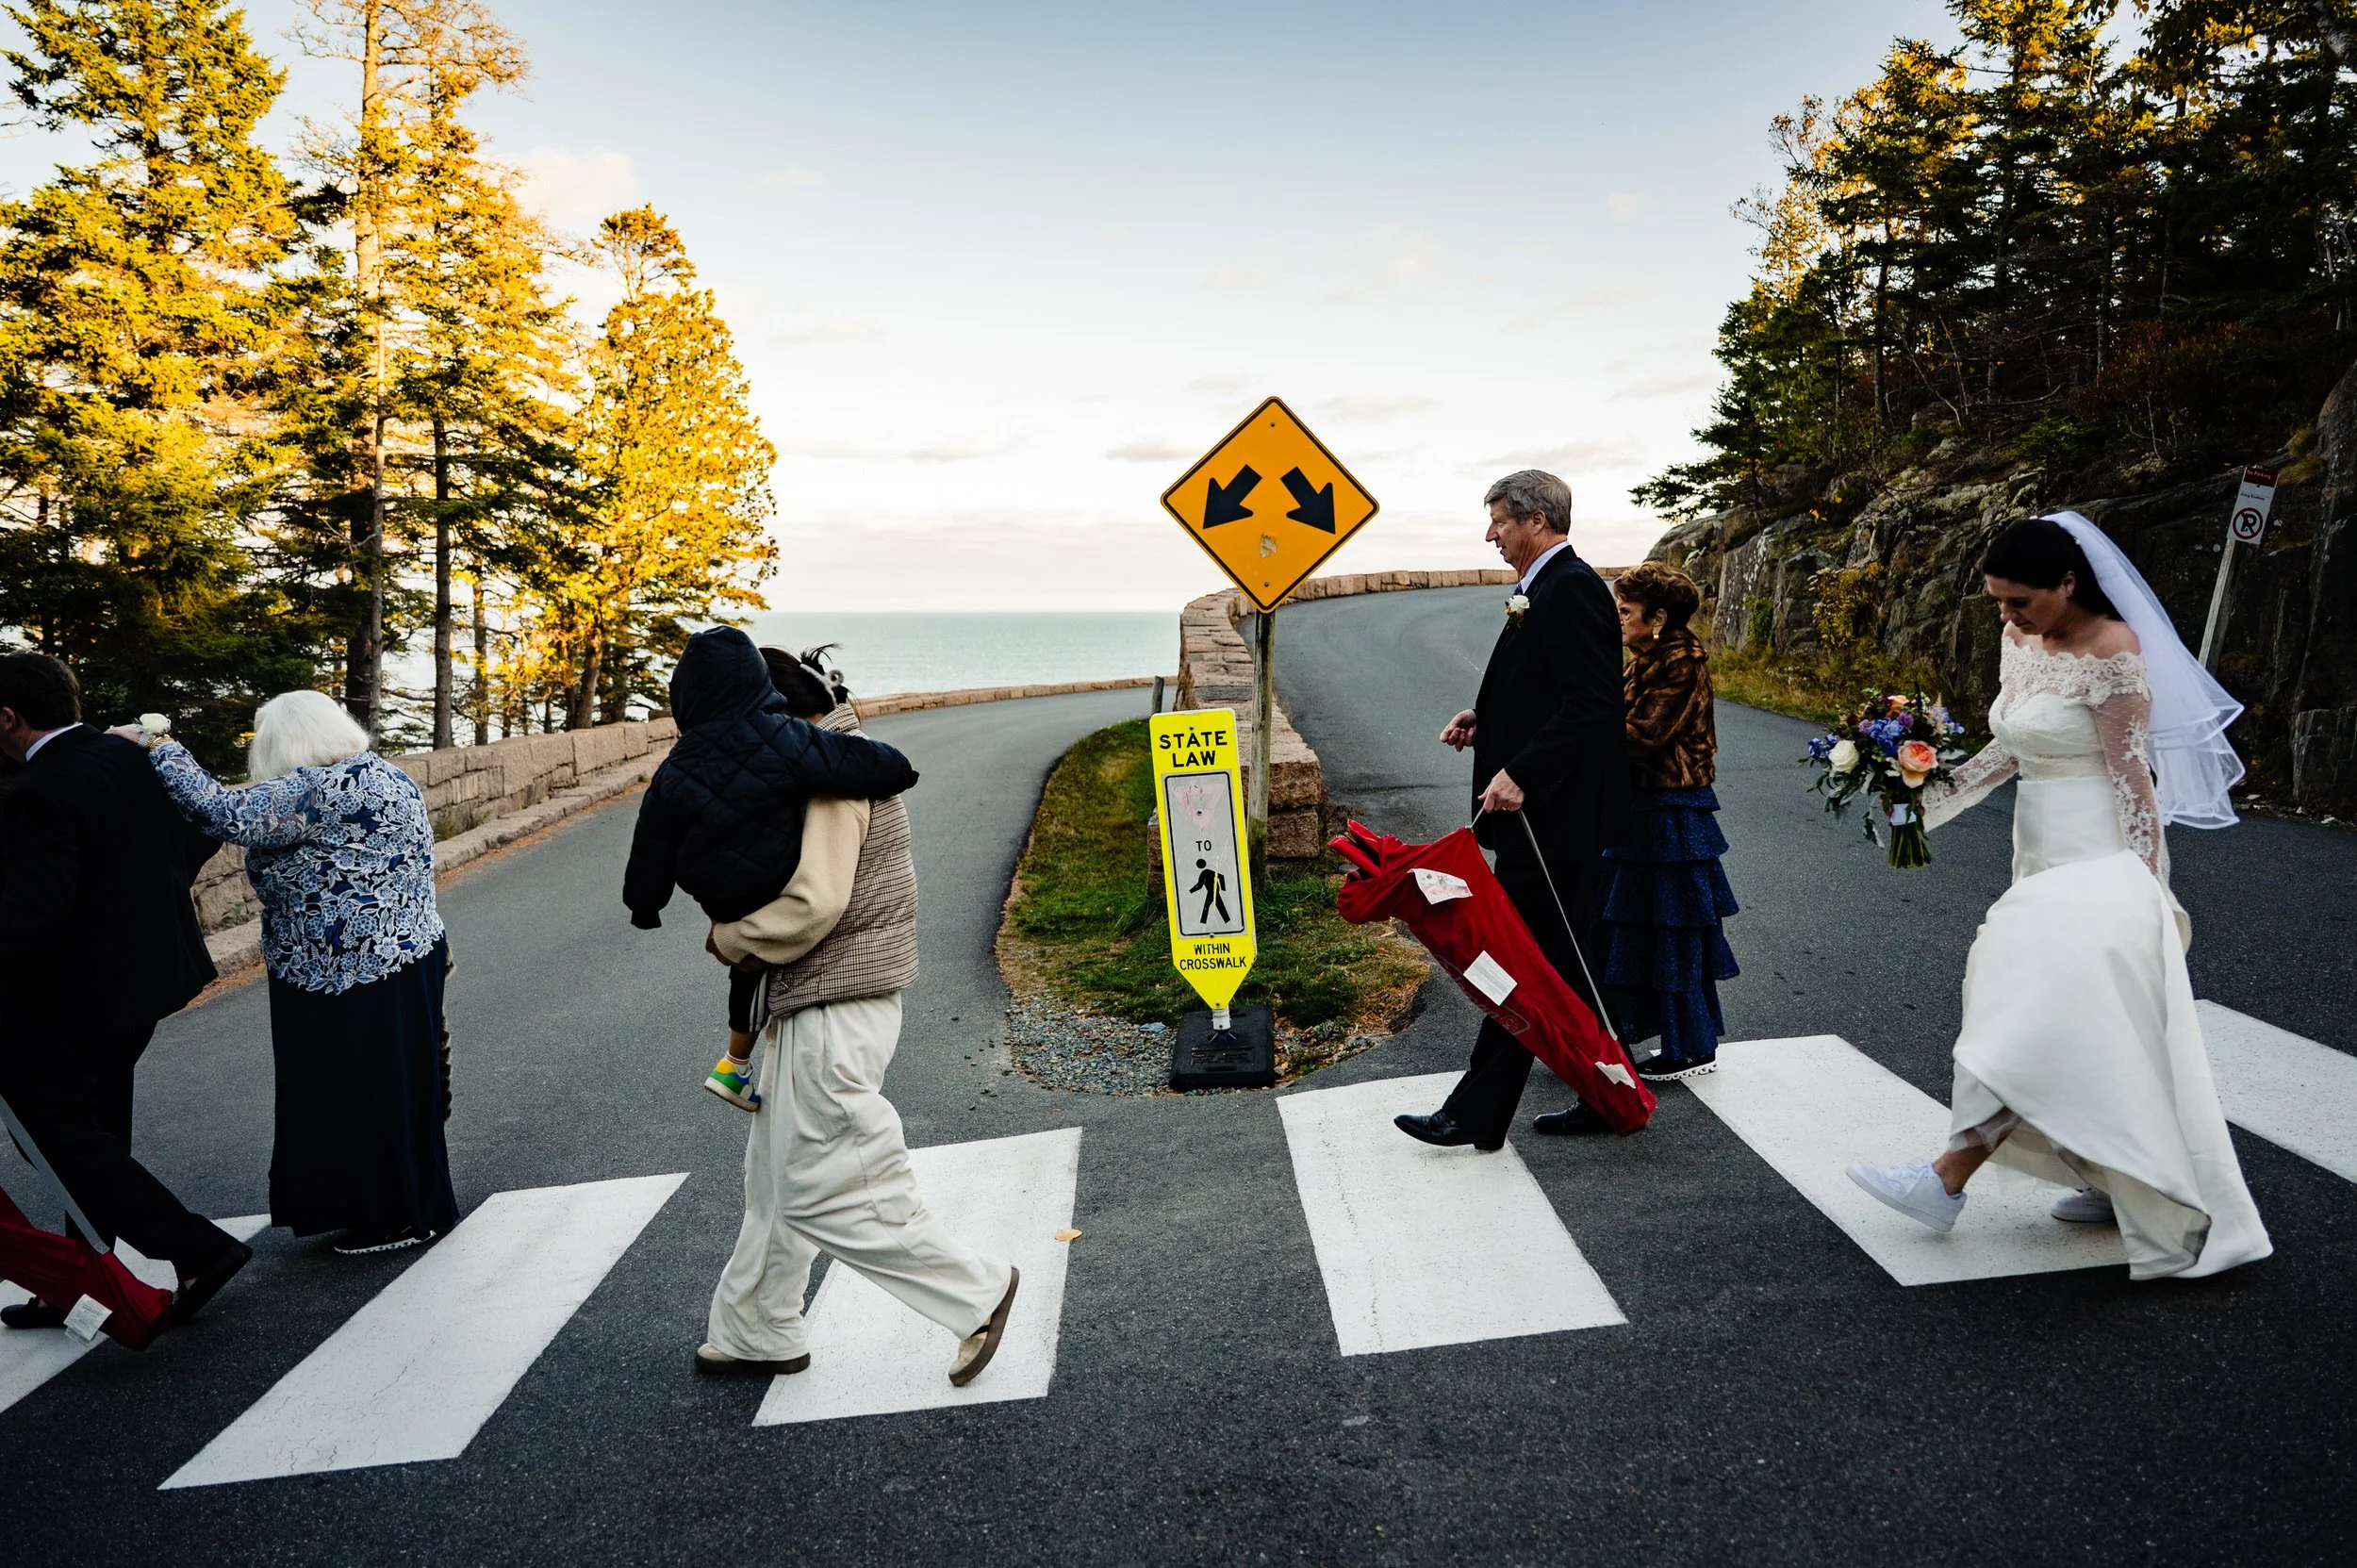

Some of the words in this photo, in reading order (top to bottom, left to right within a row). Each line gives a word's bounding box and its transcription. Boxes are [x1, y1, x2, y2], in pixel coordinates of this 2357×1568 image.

[2254, 471, 2271, 480] Parking
[1160, 731, 1228, 750] STATE
[1172, 751, 1215, 767] LAW
[1195, 840, 1211, 851] TO
[1194, 943, 1230, 955] WITHIN
[1179, 956, 1246, 970] CROSSWALK
